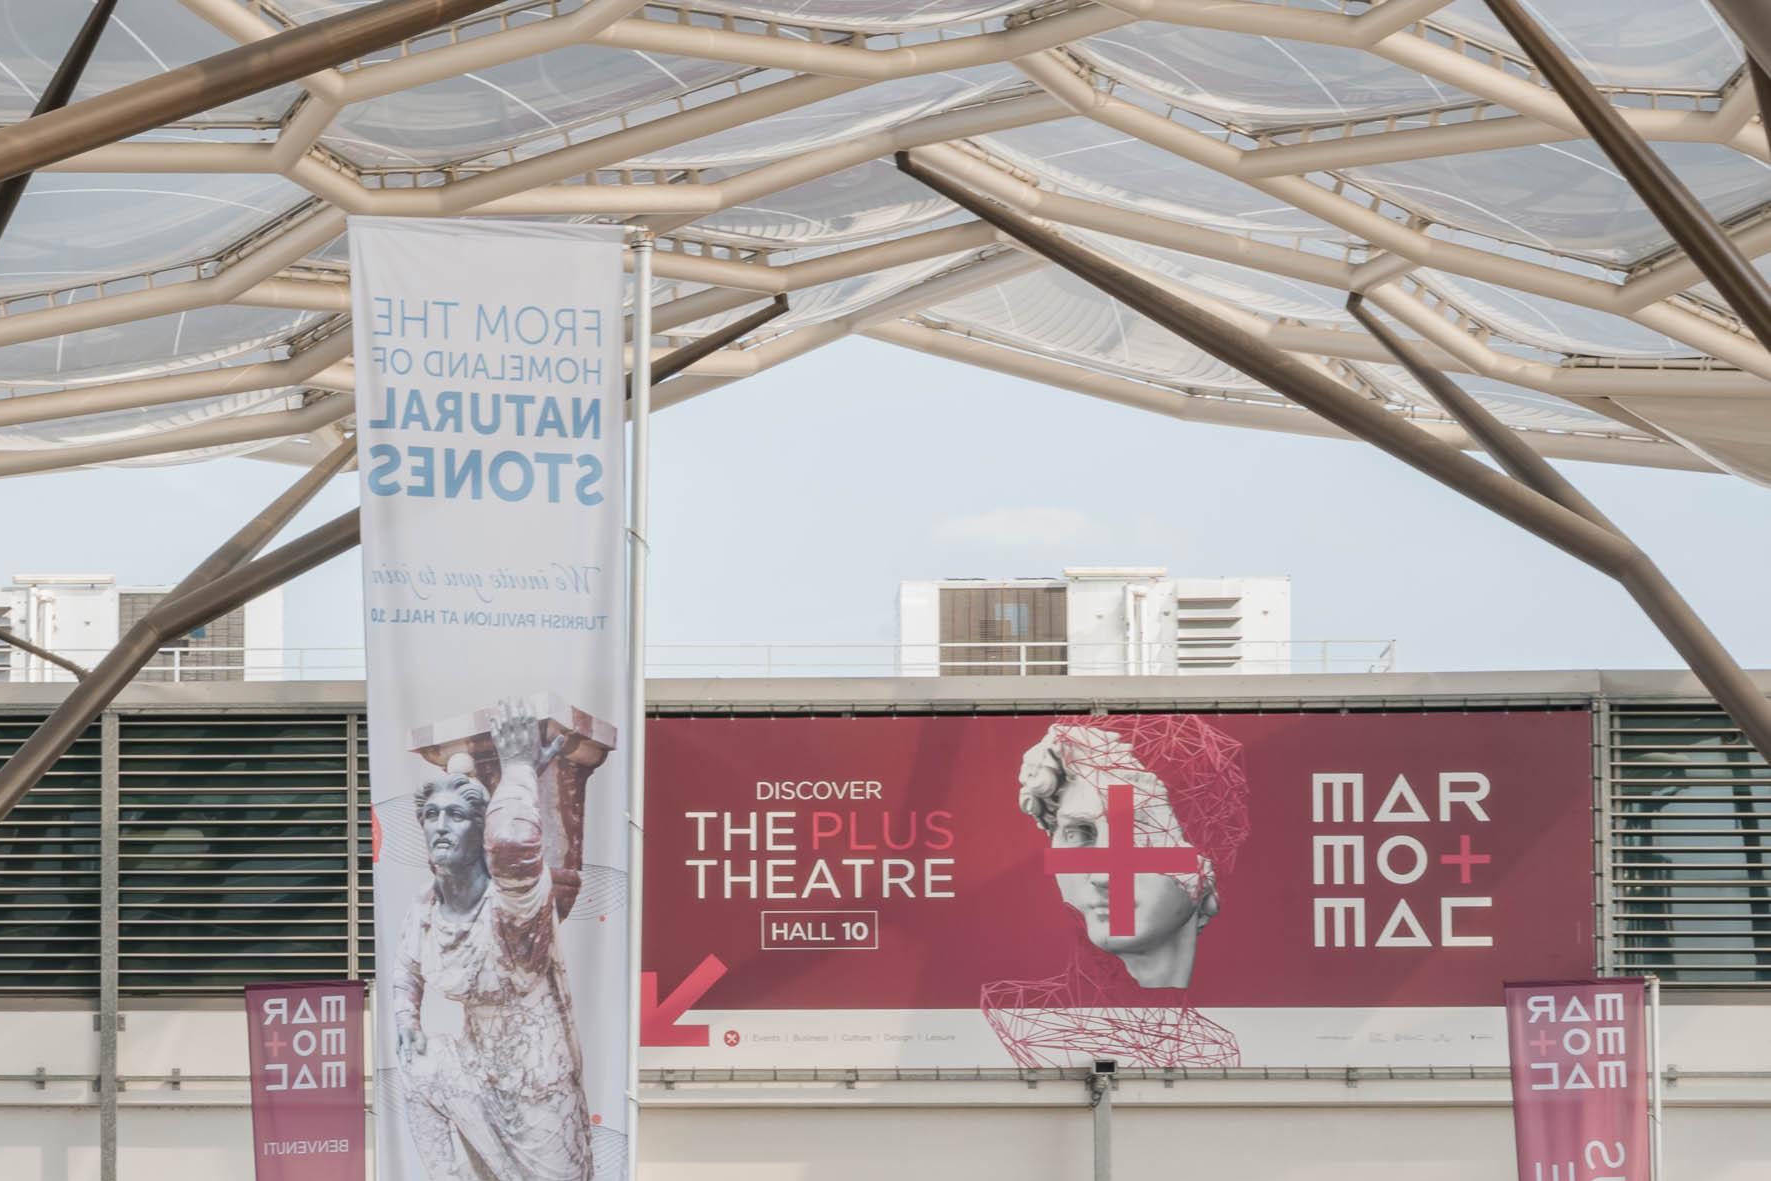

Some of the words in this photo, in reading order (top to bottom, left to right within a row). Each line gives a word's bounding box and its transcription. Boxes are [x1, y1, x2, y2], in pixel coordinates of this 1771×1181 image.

[756, 781, 883, 801] DISCOVER
[1312, 772, 1492, 823] MAR
[685, 811, 797, 851] THE
[812, 811, 955, 850] PLUS
[685, 858, 956, 899] THEATRE
[771, 921, 835, 941] HALL
[841, 921, 869, 941] 10
[1313, 897, 1493, 948] MAC
